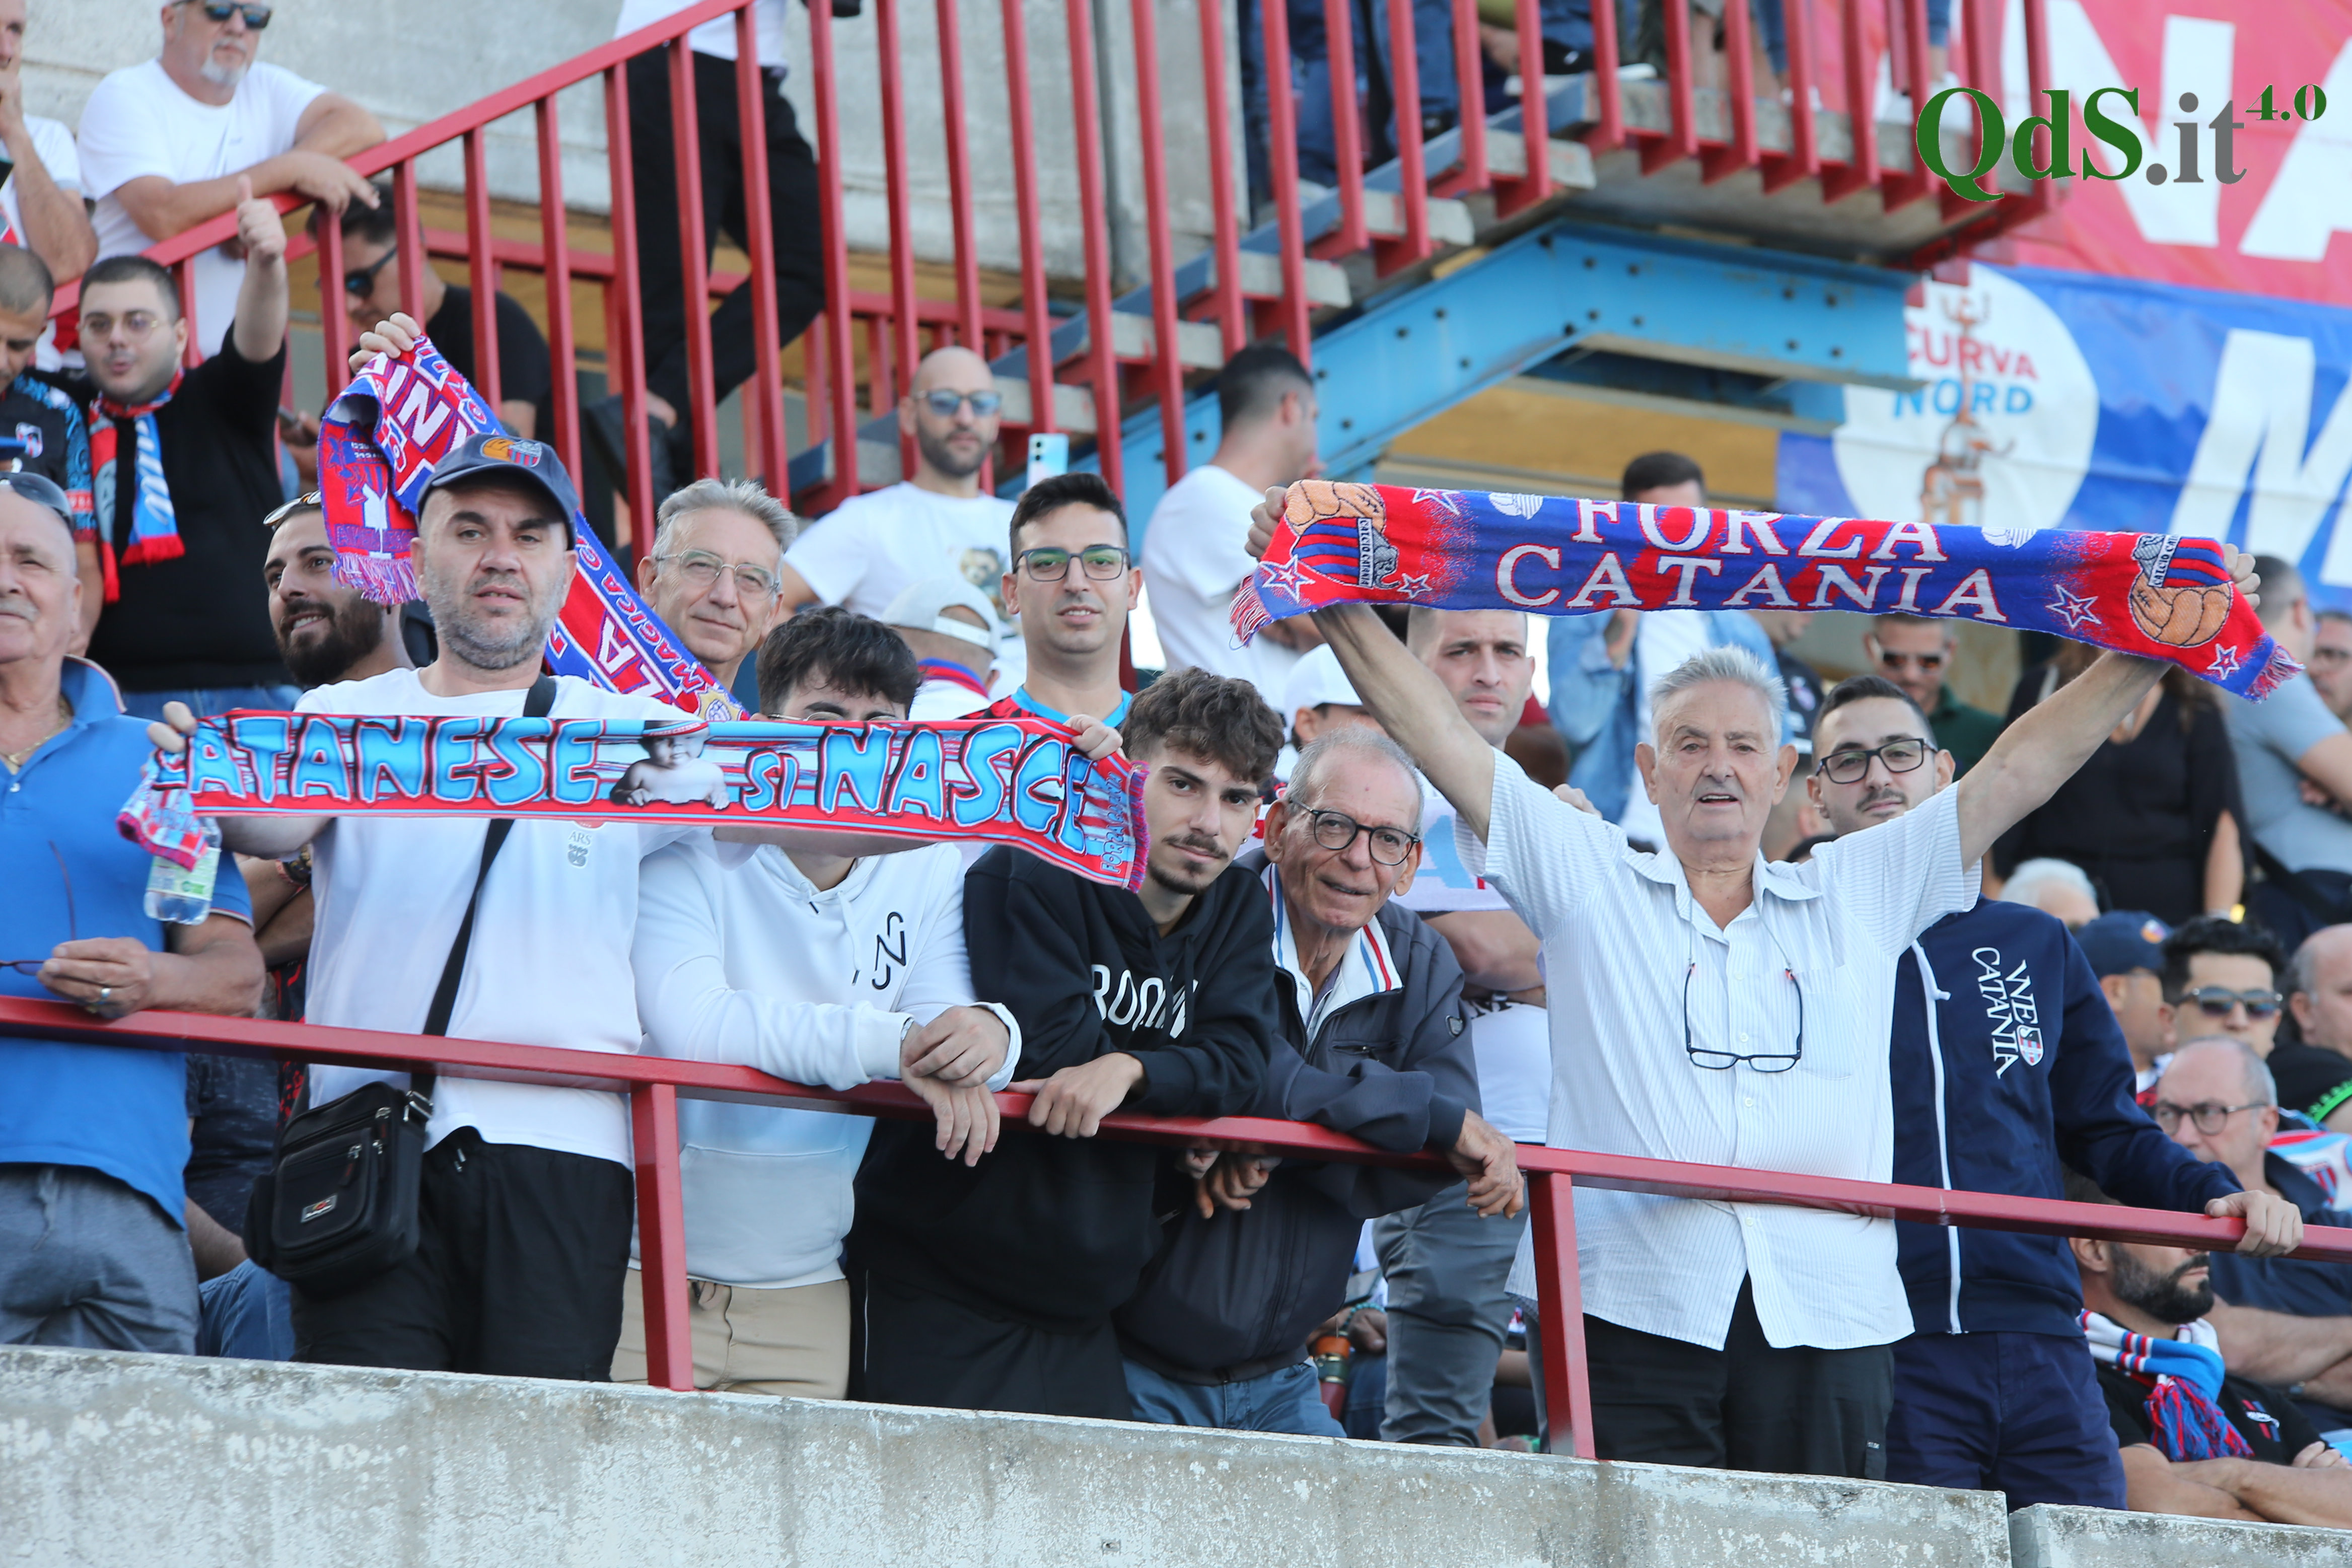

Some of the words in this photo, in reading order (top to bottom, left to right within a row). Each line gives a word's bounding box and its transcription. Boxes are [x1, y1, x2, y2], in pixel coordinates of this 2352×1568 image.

[1894, 378, 2033, 418] NORD
[1571, 498, 1948, 561] FORZA
[1496, 543, 2008, 622] CATANIA
[601, 571, 705, 693] MAGICA
[743, 748, 799, 812] SI
[820, 719, 1094, 856] NASCE
[568, 830, 592, 846] ARS
[1101, 823, 1124, 874] FORZA
[1972, 947, 2019, 1080] CATANIA
